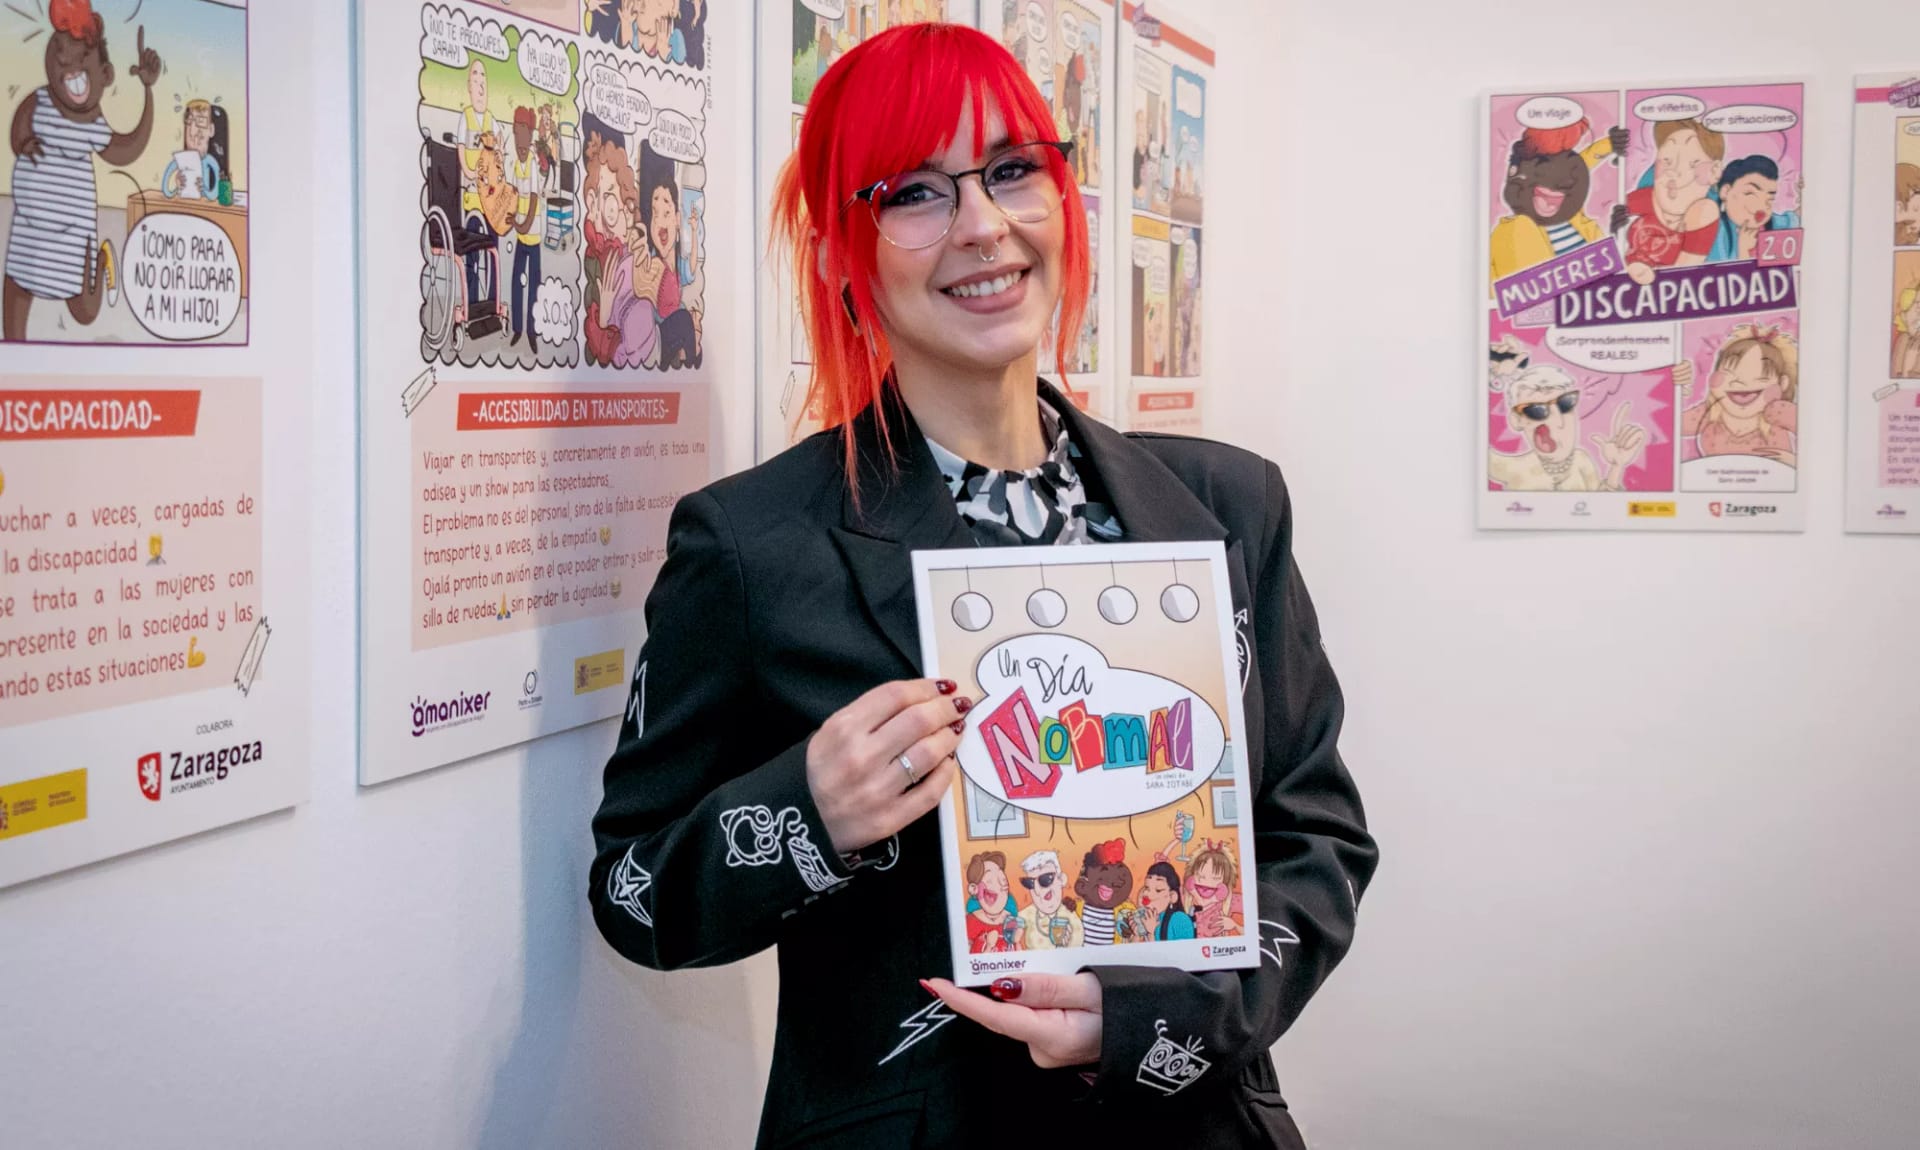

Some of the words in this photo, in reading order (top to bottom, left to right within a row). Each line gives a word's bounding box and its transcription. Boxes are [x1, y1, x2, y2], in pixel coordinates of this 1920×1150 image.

[1527, 107, 1541, 119] Un
[1640, 104, 1655, 114] en
[1704, 116, 1725, 127] por
[141, 224, 186, 261] ¡COMO
[191, 235, 225, 262] PARA
[135, 265, 156, 287] NO
[160, 261, 185, 290] OÍR
[188, 265, 235, 292] LLORAR
[1500, 246, 1617, 310] MUJERES
[145, 298, 155, 320] A
[160, 297, 176, 323] MI
[182, 298, 220, 326] HIJO!
[1559, 268, 1791, 325] DISCAPACIDAD
[0, 400, 162, 433] ISCAPACIDAD-
[573, 400, 588, 421] EN
[423, 450, 455, 475] Viajar
[461, 452, 473, 469] en
[479, 448, 536, 470] transportes
[553, 443, 617, 463] concretamente
[620, 445, 631, 459] en
[660, 443, 669, 456] es
[423, 482, 456, 501] odisea
[460, 488, 466, 503] y
[469, 483, 481, 497] un
[485, 476, 509, 498] show
[512, 480, 535, 498] para
[538, 475, 550, 492] las
[67, 511, 77, 528] a
[92, 505, 142, 529] veces,
[155, 496, 225, 528] cargadas
[236, 493, 254, 516] de
[423, 513, 433, 534] El
[436, 510, 484, 536] problema
[486, 512, 498, 527] no
[502, 510, 511, 526] es
[515, 504, 528, 524] del
[574, 502, 592, 518] sino
[593, 498, 604, 516] de
[605, 497, 613, 514] la
[615, 496, 634, 518] falta
[636, 494, 646, 511] de
[1726, 503, 1776, 516] Zaragoza
[4, 549, 19, 575] la
[28, 540, 138, 574] discapacidad
[423, 540, 481, 566] transporte
[496, 543, 502, 555] a
[537, 532, 548, 550] de
[551, 531, 559, 548] la
[32, 586, 77, 613] trata
[94, 588, 104, 604] a
[120, 579, 142, 602] las
[156, 574, 215, 601] mujeres
[228, 569, 254, 588] con
[423, 574, 450, 601] Ojalá
[453, 571, 488, 598] pronto
[491, 571, 503, 585] un
[506, 564, 531, 583] avión
[533, 565, 544, 580] en
[546, 560, 555, 578] el
[557, 560, 573, 581] que
[575, 556, 600, 577] poder
[603, 552, 630, 570] entrar
[423, 607, 443, 629] silla
[446, 605, 459, 624] de
[463, 599, 497, 621] ruedas
[511, 597, 524, 612] sin
[527, 589, 559, 614] perder
[561, 586, 570, 603] la
[573, 582, 608, 607] dignidad
[88, 624, 108, 645] en
[118, 617, 132, 641] la
[143, 604, 209, 638] sociedad
[217, 610, 226, 631] y
[234, 602, 253, 624] las
[47, 663, 92, 693] estas
[98, 651, 185, 684] situaciones
[997, 648, 1021, 679] Un
[1026, 654, 1094, 704] Día
[196, 719, 233, 736] COLABORA
[411, 690, 491, 737] amanixer
[170, 740, 263, 781] Zaragoza
[970, 957, 1027, 975] amanixer
[1213, 945, 1246, 956] Zaragoza
